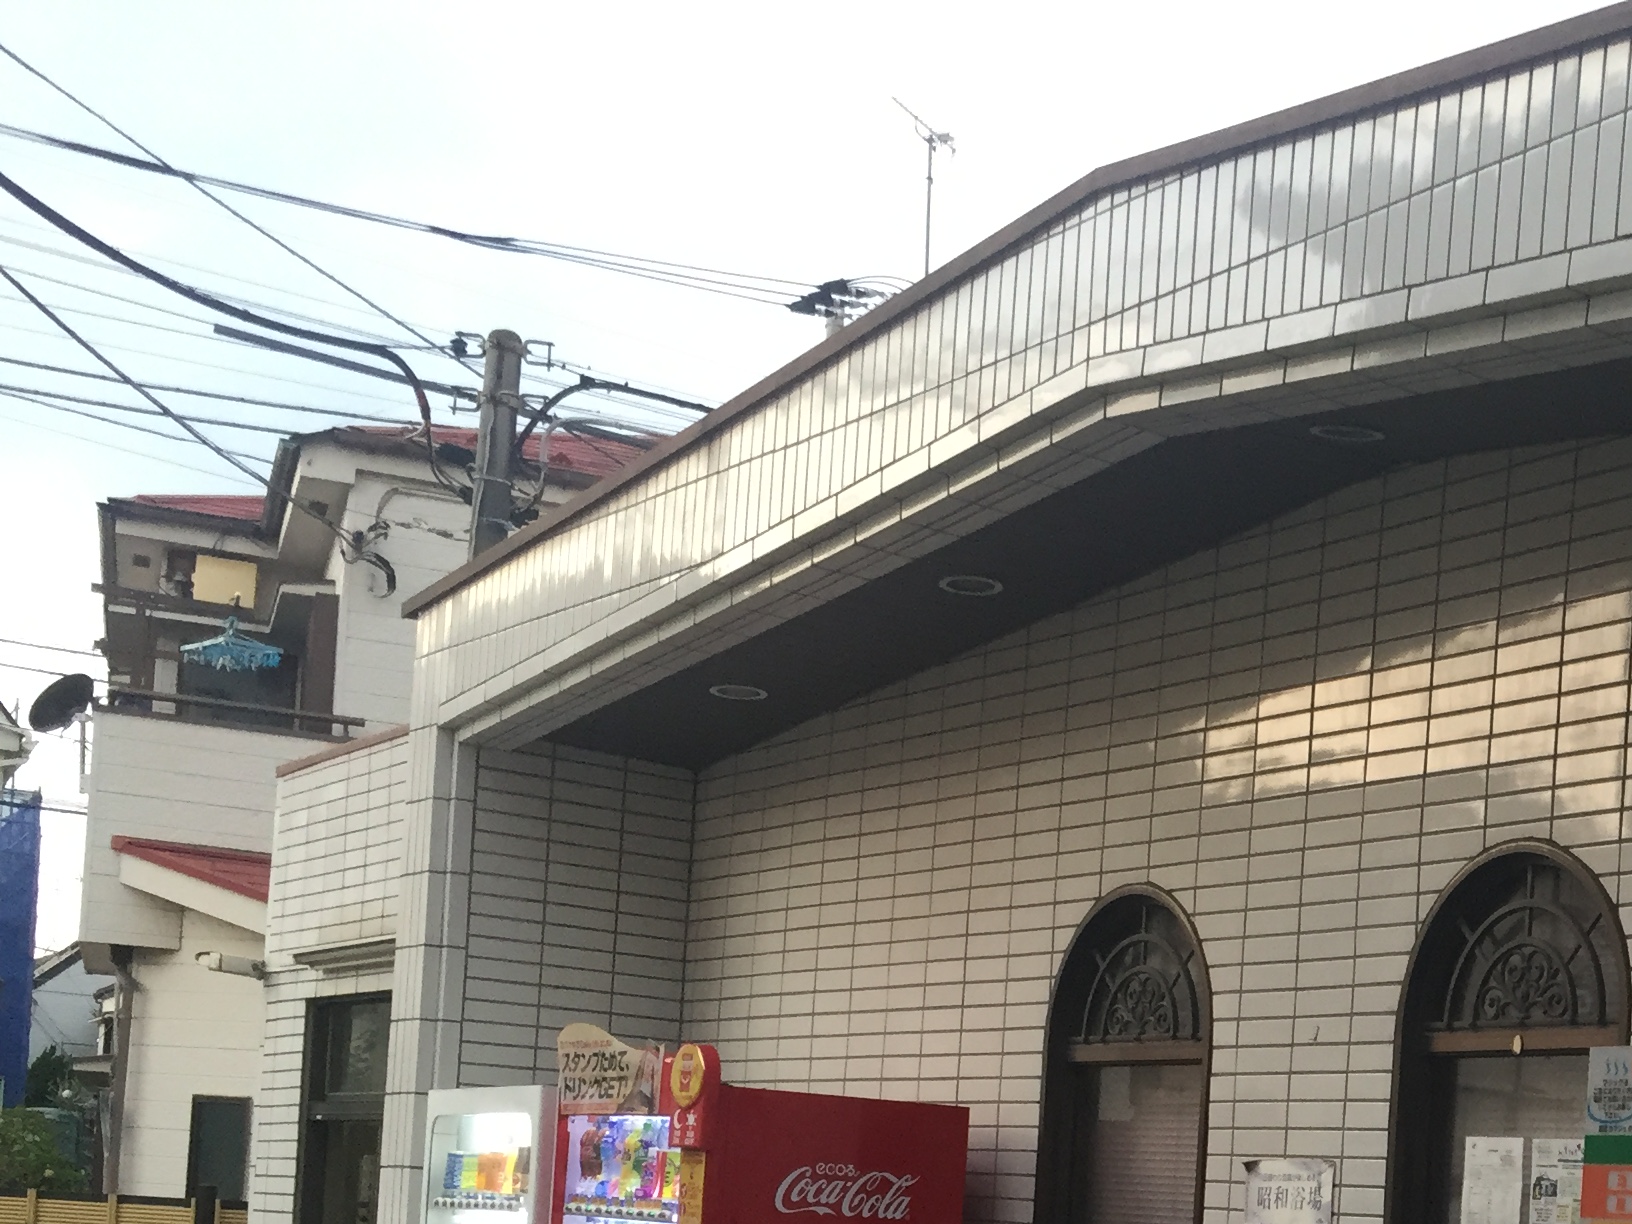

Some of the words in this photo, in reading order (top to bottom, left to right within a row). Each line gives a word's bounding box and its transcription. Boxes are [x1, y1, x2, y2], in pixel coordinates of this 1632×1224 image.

[774, 1166, 921, 1220] Coca-Cola
[1257, 1185, 1323, 1211] 昭和浴場
